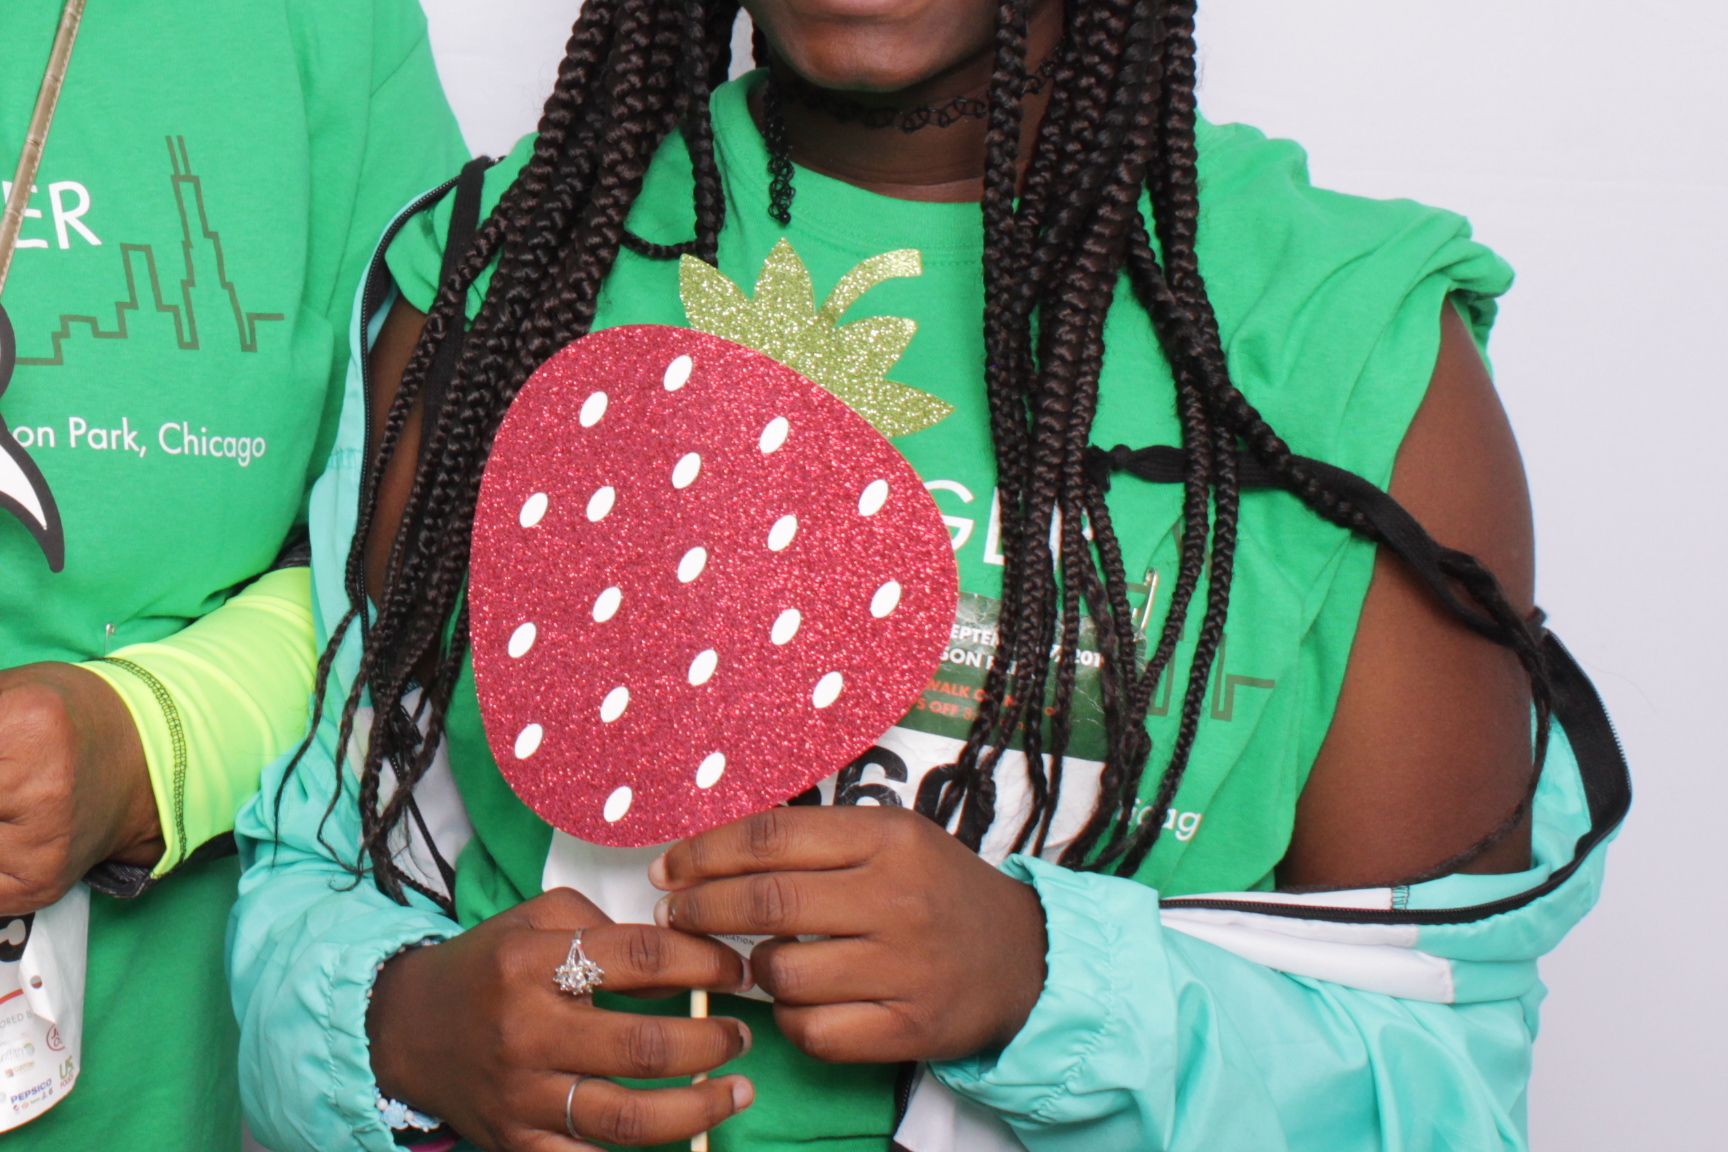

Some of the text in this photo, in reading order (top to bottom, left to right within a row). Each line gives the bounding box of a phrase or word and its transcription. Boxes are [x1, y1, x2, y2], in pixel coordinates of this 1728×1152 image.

[69, 416, 147, 458] Park,
[158, 421, 266, 467] Chicago
[11, 1078, 52, 1104] PEPSICO
